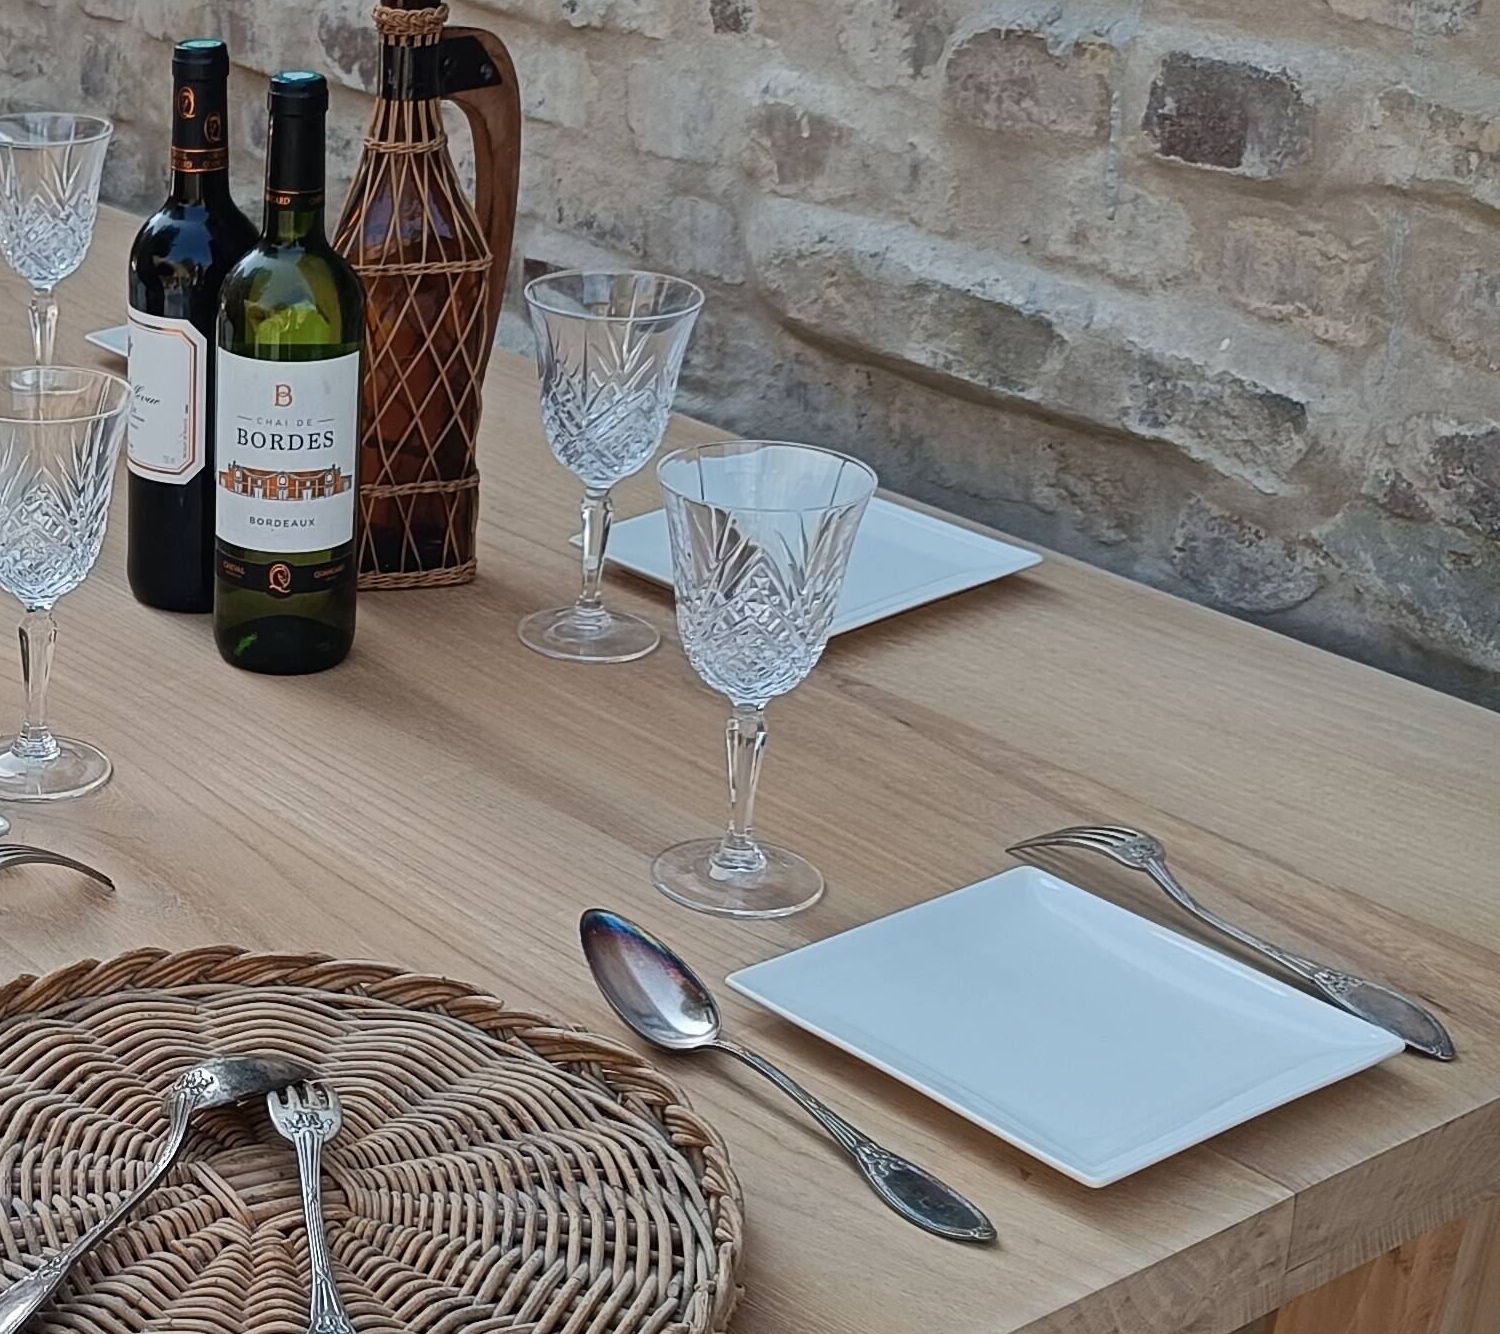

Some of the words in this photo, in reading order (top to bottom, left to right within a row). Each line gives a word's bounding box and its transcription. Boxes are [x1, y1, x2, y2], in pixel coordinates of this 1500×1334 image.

[274, 384, 293, 407] B
[257, 417, 288, 427] CHAI
[296, 418, 313, 427] DE
[237, 427, 334, 451] BORDES
[249, 516, 315, 528] BORDEAUX
